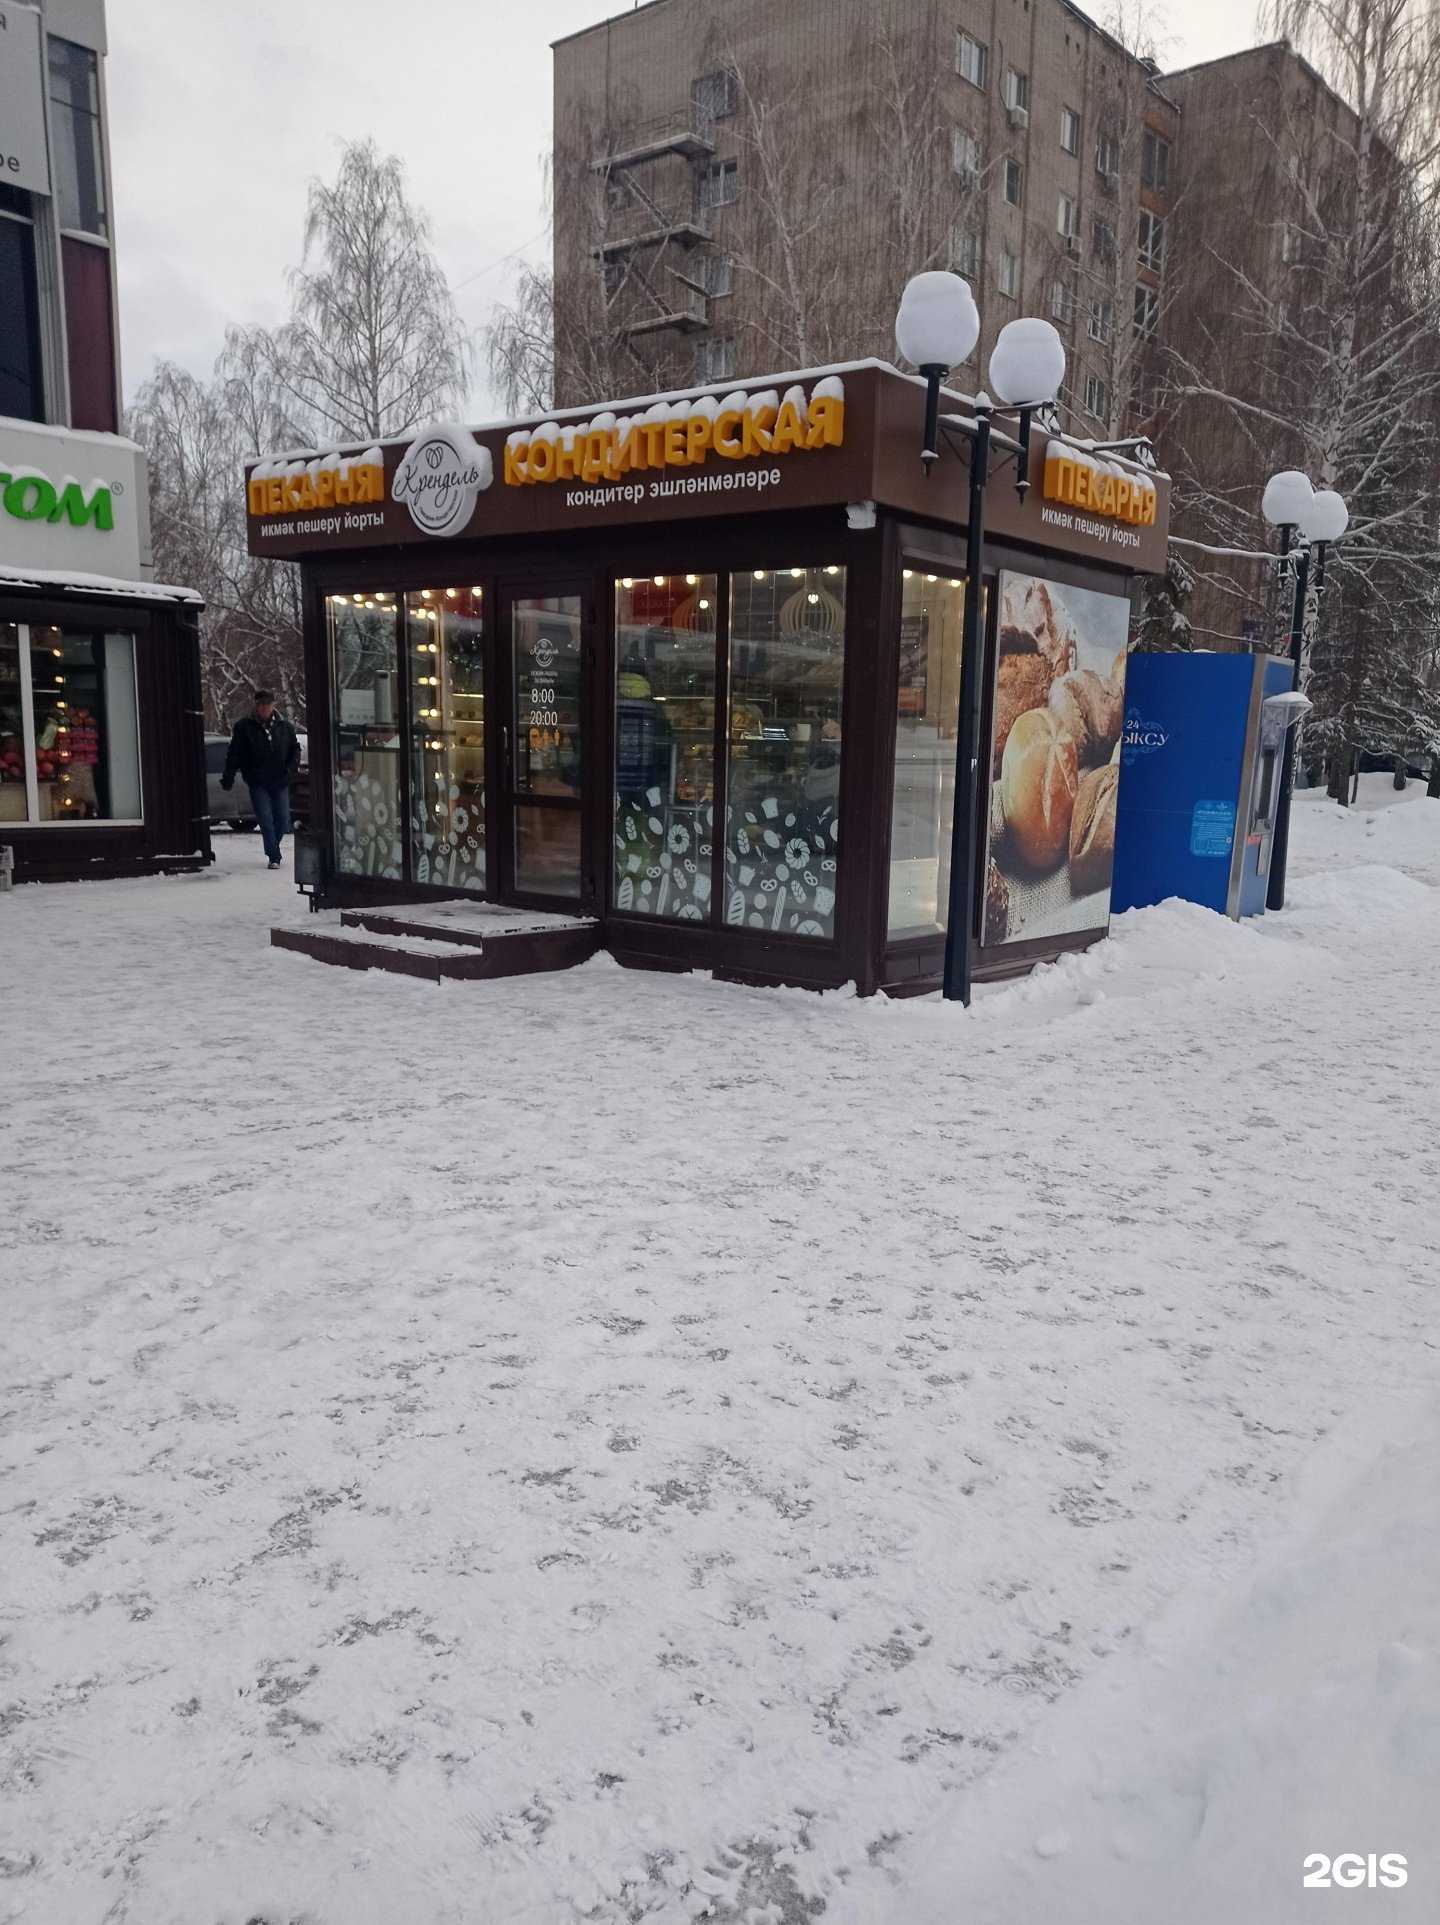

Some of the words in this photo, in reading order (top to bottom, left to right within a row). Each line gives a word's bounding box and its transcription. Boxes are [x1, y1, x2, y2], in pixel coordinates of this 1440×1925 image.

[504, 395, 845, 486] КОНДИТЕРСКАЯ
[249, 460, 385, 516] ПЕКАРНЯ
[394, 464, 480, 508] Крендель
[566, 483, 645, 507] кондитер
[649, 468, 781, 498] эшләнмәләре
[1044, 456, 1158, 526] ПЕКАРНЯ
[261, 522, 296, 537] икмәк
[344, 511, 385, 531] йорты
[1041, 507, 1073, 529] икмәк
[1112, 524, 1140, 548] йорты
[531, 688, 555, 703] 8:00
[530, 711, 558, 726] 20:00
[1126, 719, 1139, 729] 24
